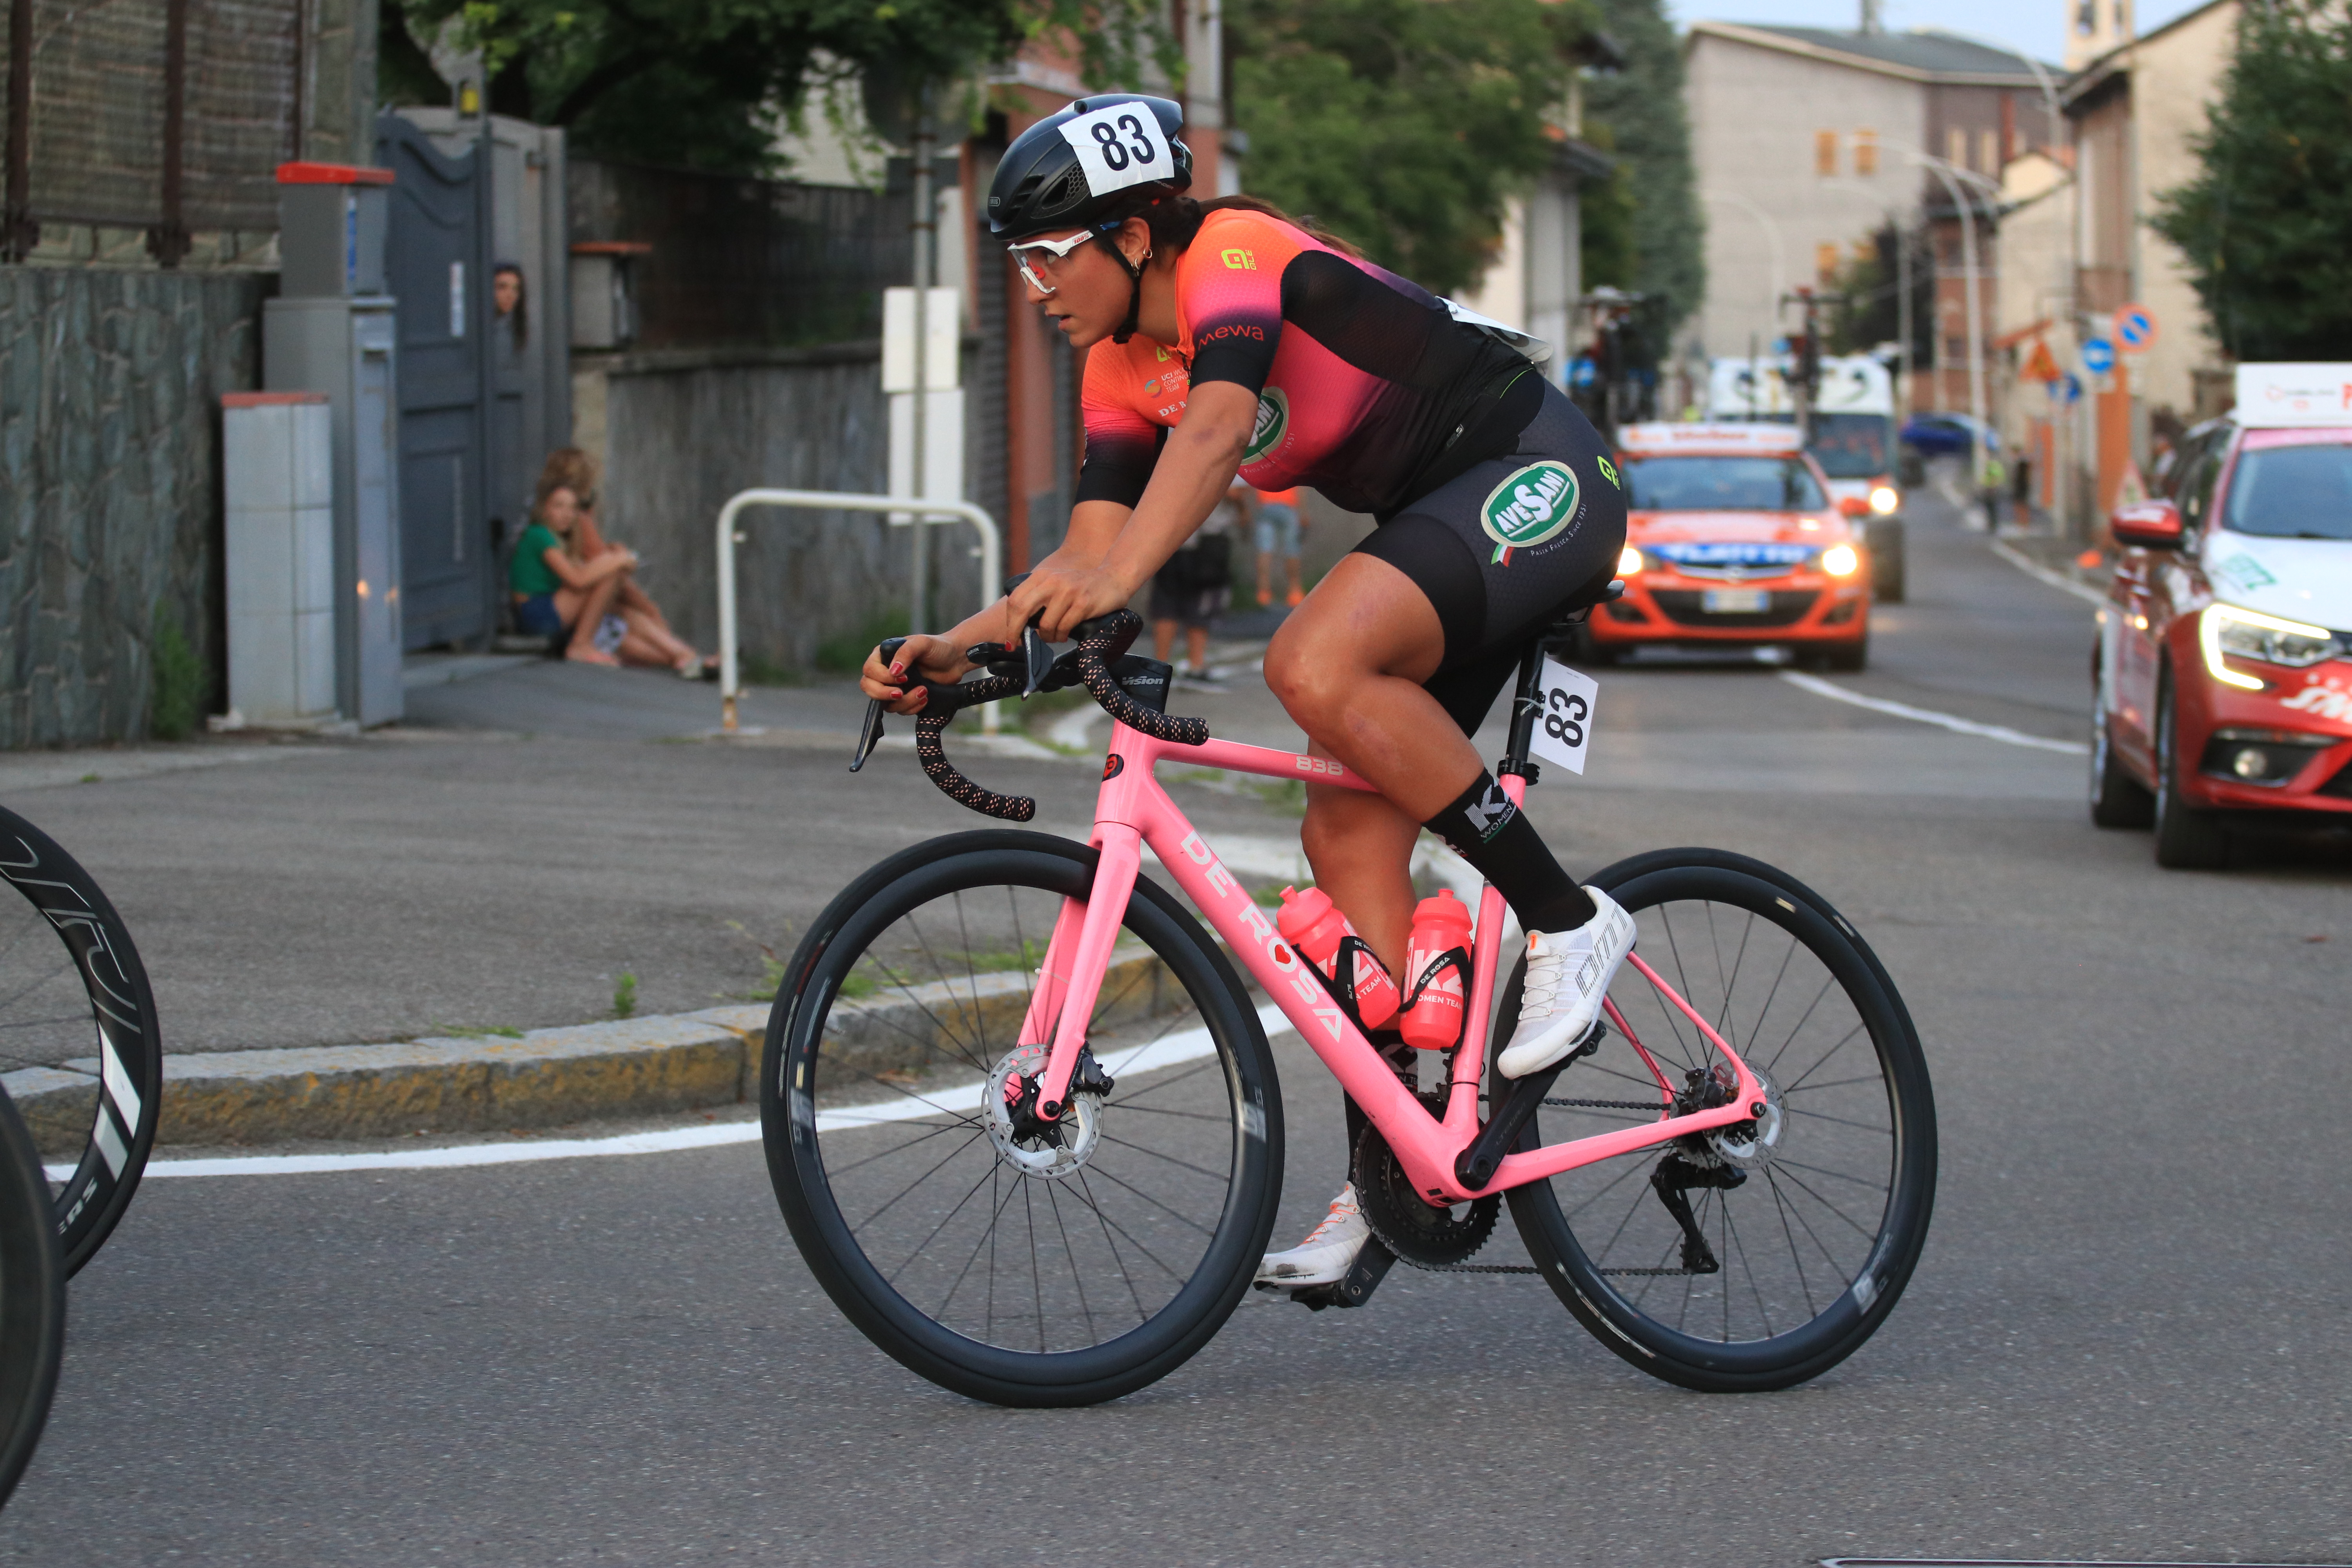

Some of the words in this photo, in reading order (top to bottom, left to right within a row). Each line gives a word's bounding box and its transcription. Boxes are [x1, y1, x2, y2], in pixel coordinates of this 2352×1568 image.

[1091, 114, 1155, 171] 83
[1074, 233, 1089, 244] 100%
[1198, 325, 1264, 351] mewa
[1161, 372, 1173, 381] UCI
[1165, 383, 1180, 393] TEAM
[1158, 404, 1178, 417] DE
[1285, 433, 1296, 448] 1951
[1495, 470, 1566, 533] AVESANI
[1578, 503, 1587, 520] 1951
[1122, 676, 1164, 685] Vision
[1545, 688, 1587, 748] 83
[1296, 756, 1343, 776] 838
[1480, 804, 1513, 838] WOMEN
[1180, 829, 1238, 898] DE
[1238, 902, 1343, 1043] ROSA
[1420, 973, 1431, 984] DE
[1430, 956, 1450, 975] ROSA
[1360, 976, 1381, 996] TEAM
[1417, 995, 1444, 1004] OMEN
